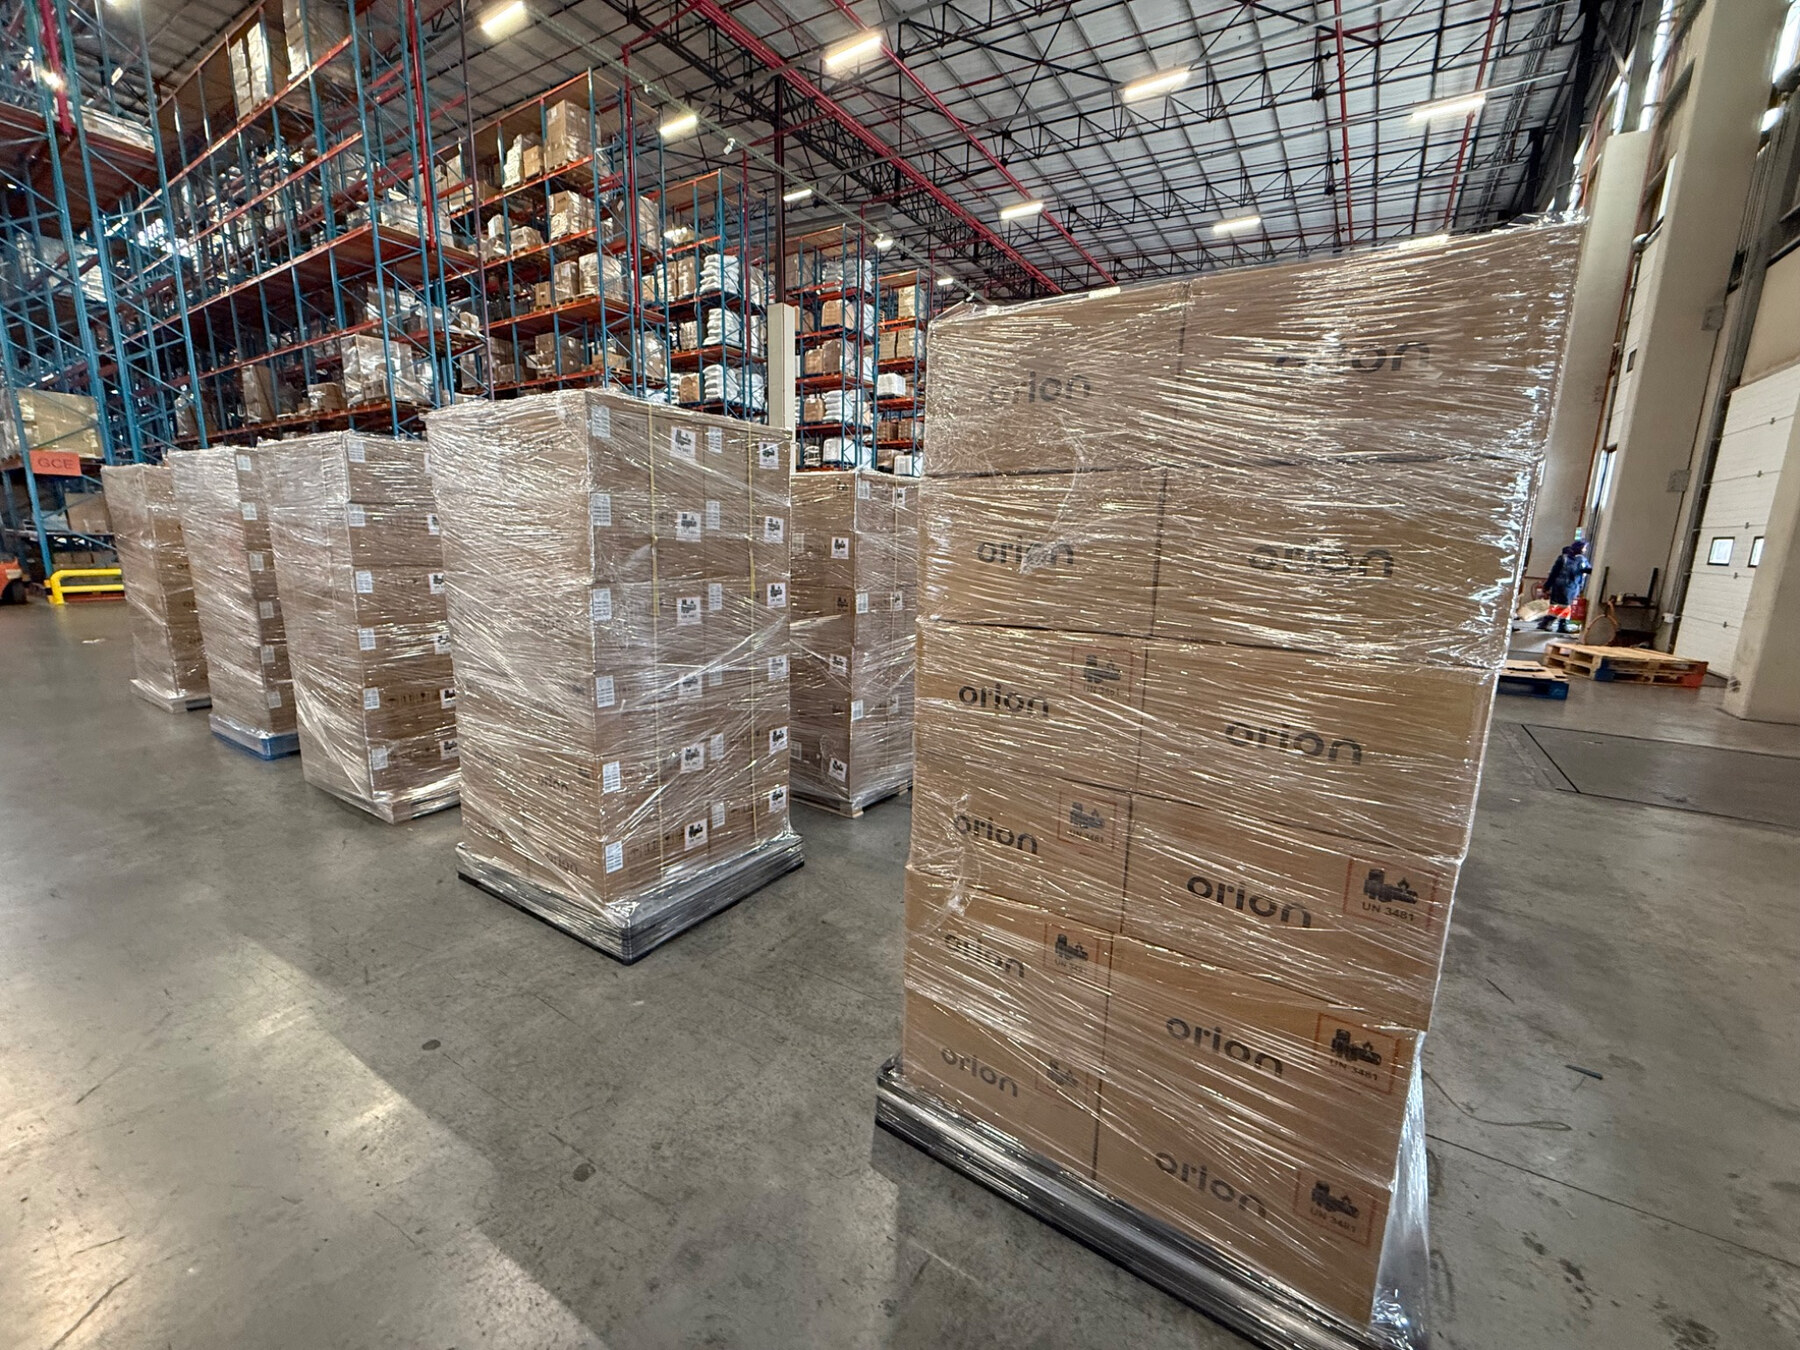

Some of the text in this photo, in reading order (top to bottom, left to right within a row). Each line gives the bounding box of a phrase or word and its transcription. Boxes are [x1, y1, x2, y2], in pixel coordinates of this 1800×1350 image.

[37, 457, 75, 470] GCE
[958, 682, 1050, 718] orion
[1224, 721, 1364, 766] orion
[953, 815, 1038, 855] orion
[1186, 875, 1313, 929] orion
[1361, 901, 1415, 922] UN 3481
[1165, 1017, 1284, 1079] orion
[940, 1047, 1019, 1098] orion
[1154, 1152, 1267, 1219] orion
